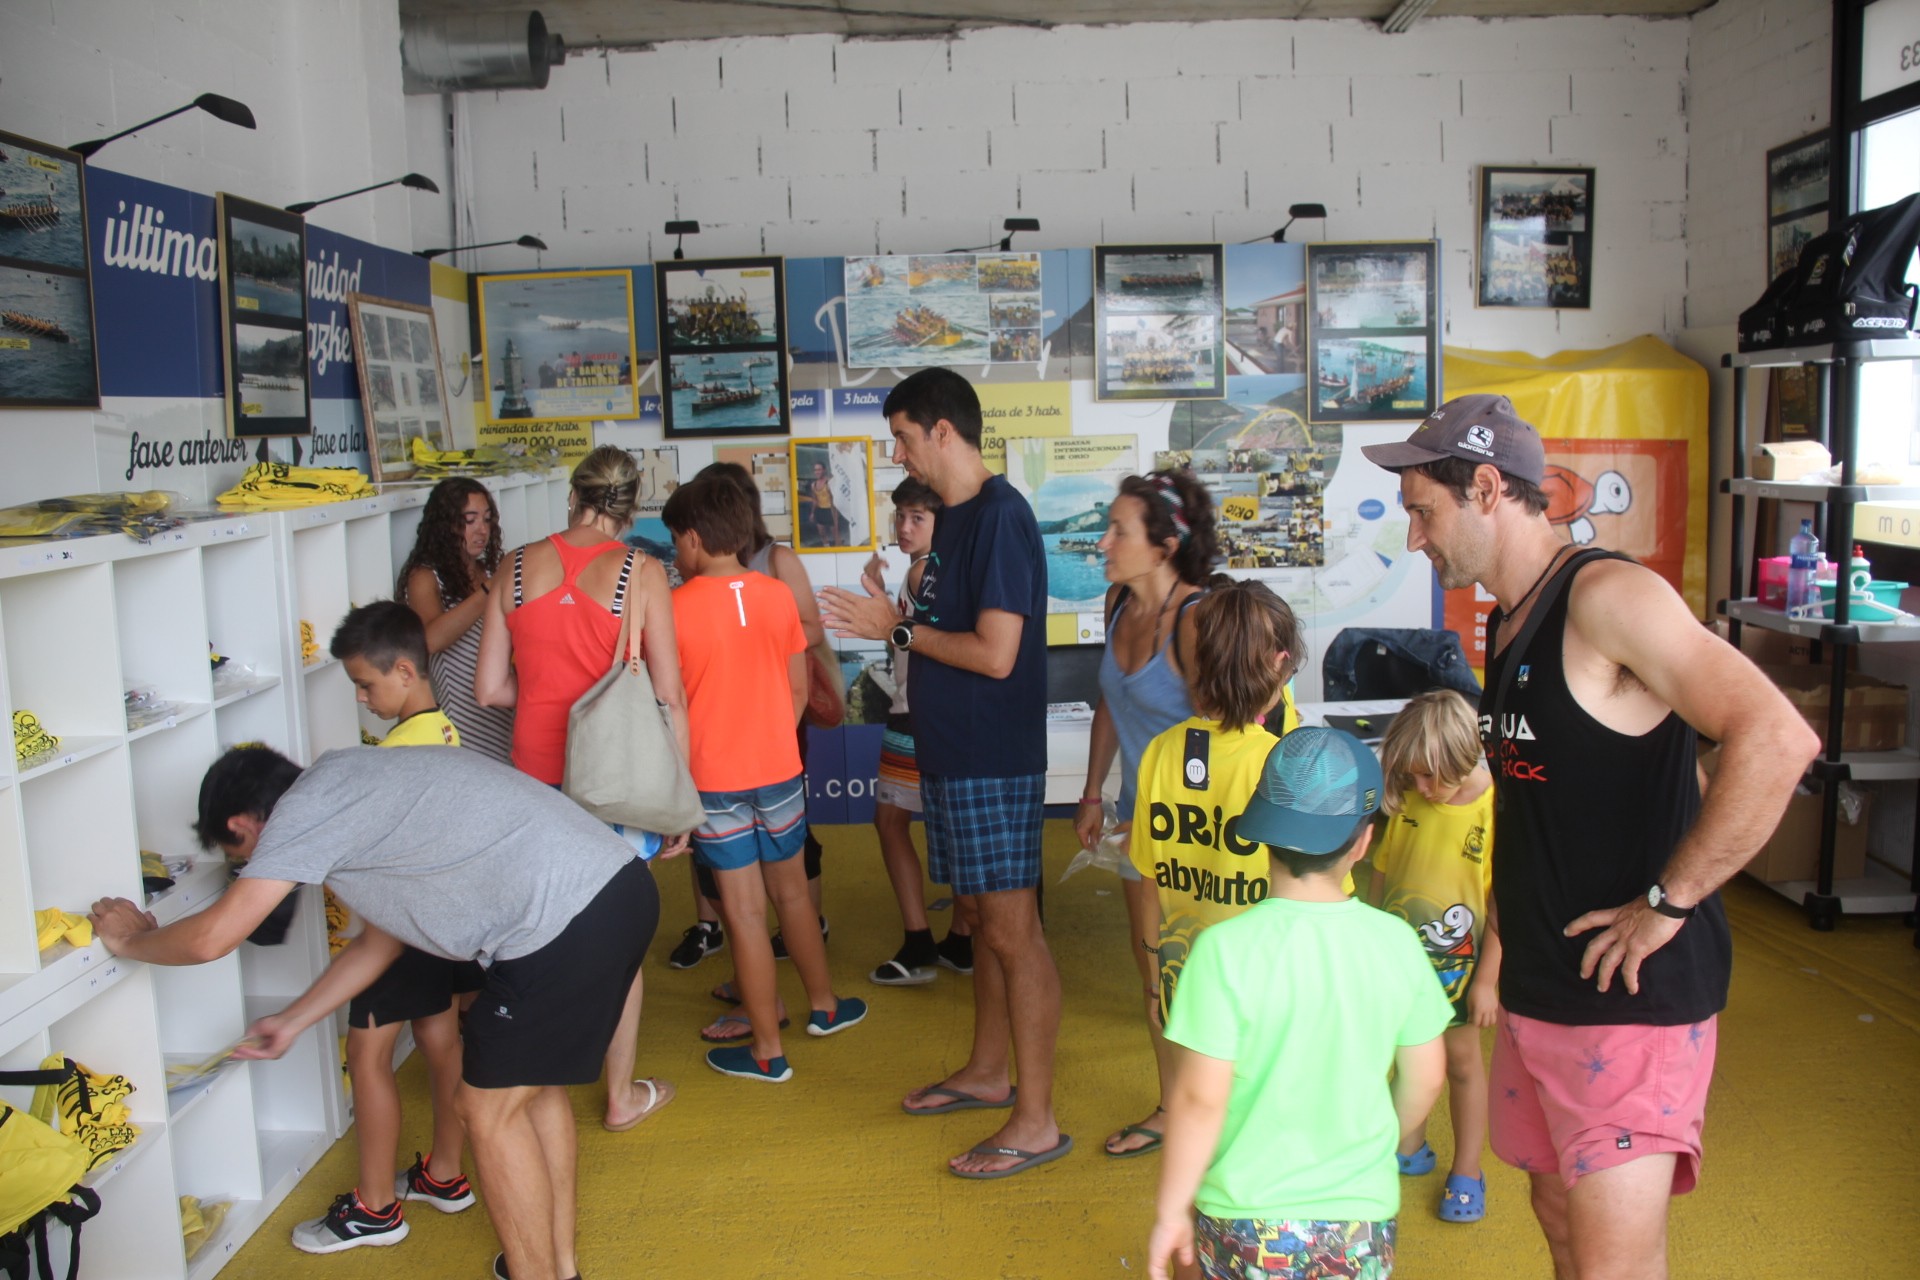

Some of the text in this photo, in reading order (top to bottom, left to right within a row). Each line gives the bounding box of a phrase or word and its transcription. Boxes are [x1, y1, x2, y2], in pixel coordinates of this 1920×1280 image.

[104, 200, 218, 281] última
[844, 391, 881, 404] 3 habs.
[1009, 407, 1022, 417] de
[1026, 405, 1033, 416] 3
[480, 423, 528, 434] viviendas
[531, 422, 544, 432] de
[309, 426, 336, 464] fase
[558, 437, 588, 447] euros
[126, 429, 249, 480] fase anterior
